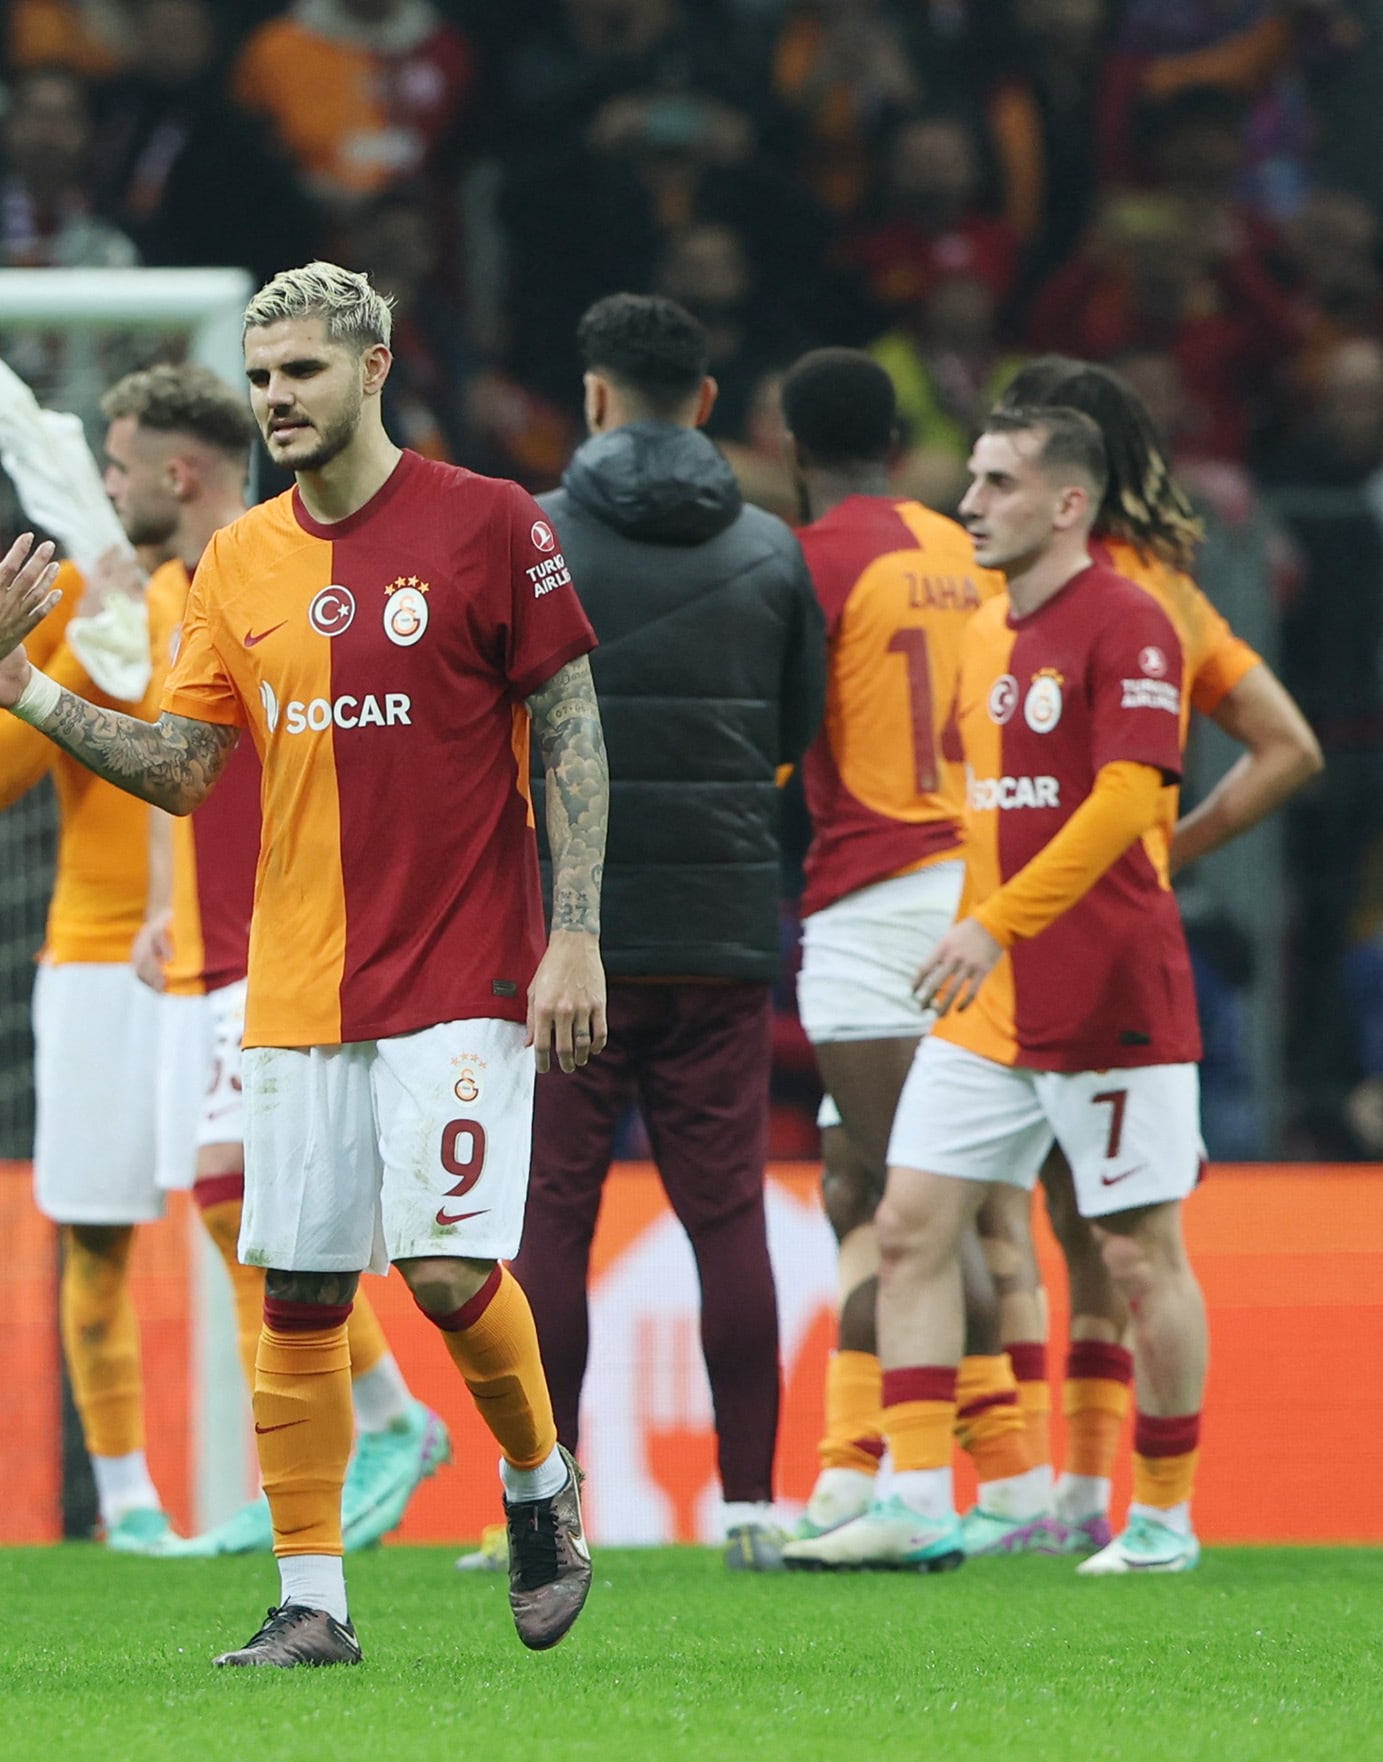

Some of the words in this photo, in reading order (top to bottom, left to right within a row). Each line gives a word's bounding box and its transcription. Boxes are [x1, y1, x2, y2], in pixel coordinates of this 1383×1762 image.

[526, 553, 566, 582] TURK
[902, 572, 981, 610] ZAHA
[285, 693, 412, 735] SOCAR
[1091, 1088, 1129, 1159] 7
[440, 1118, 486, 1197] 9
